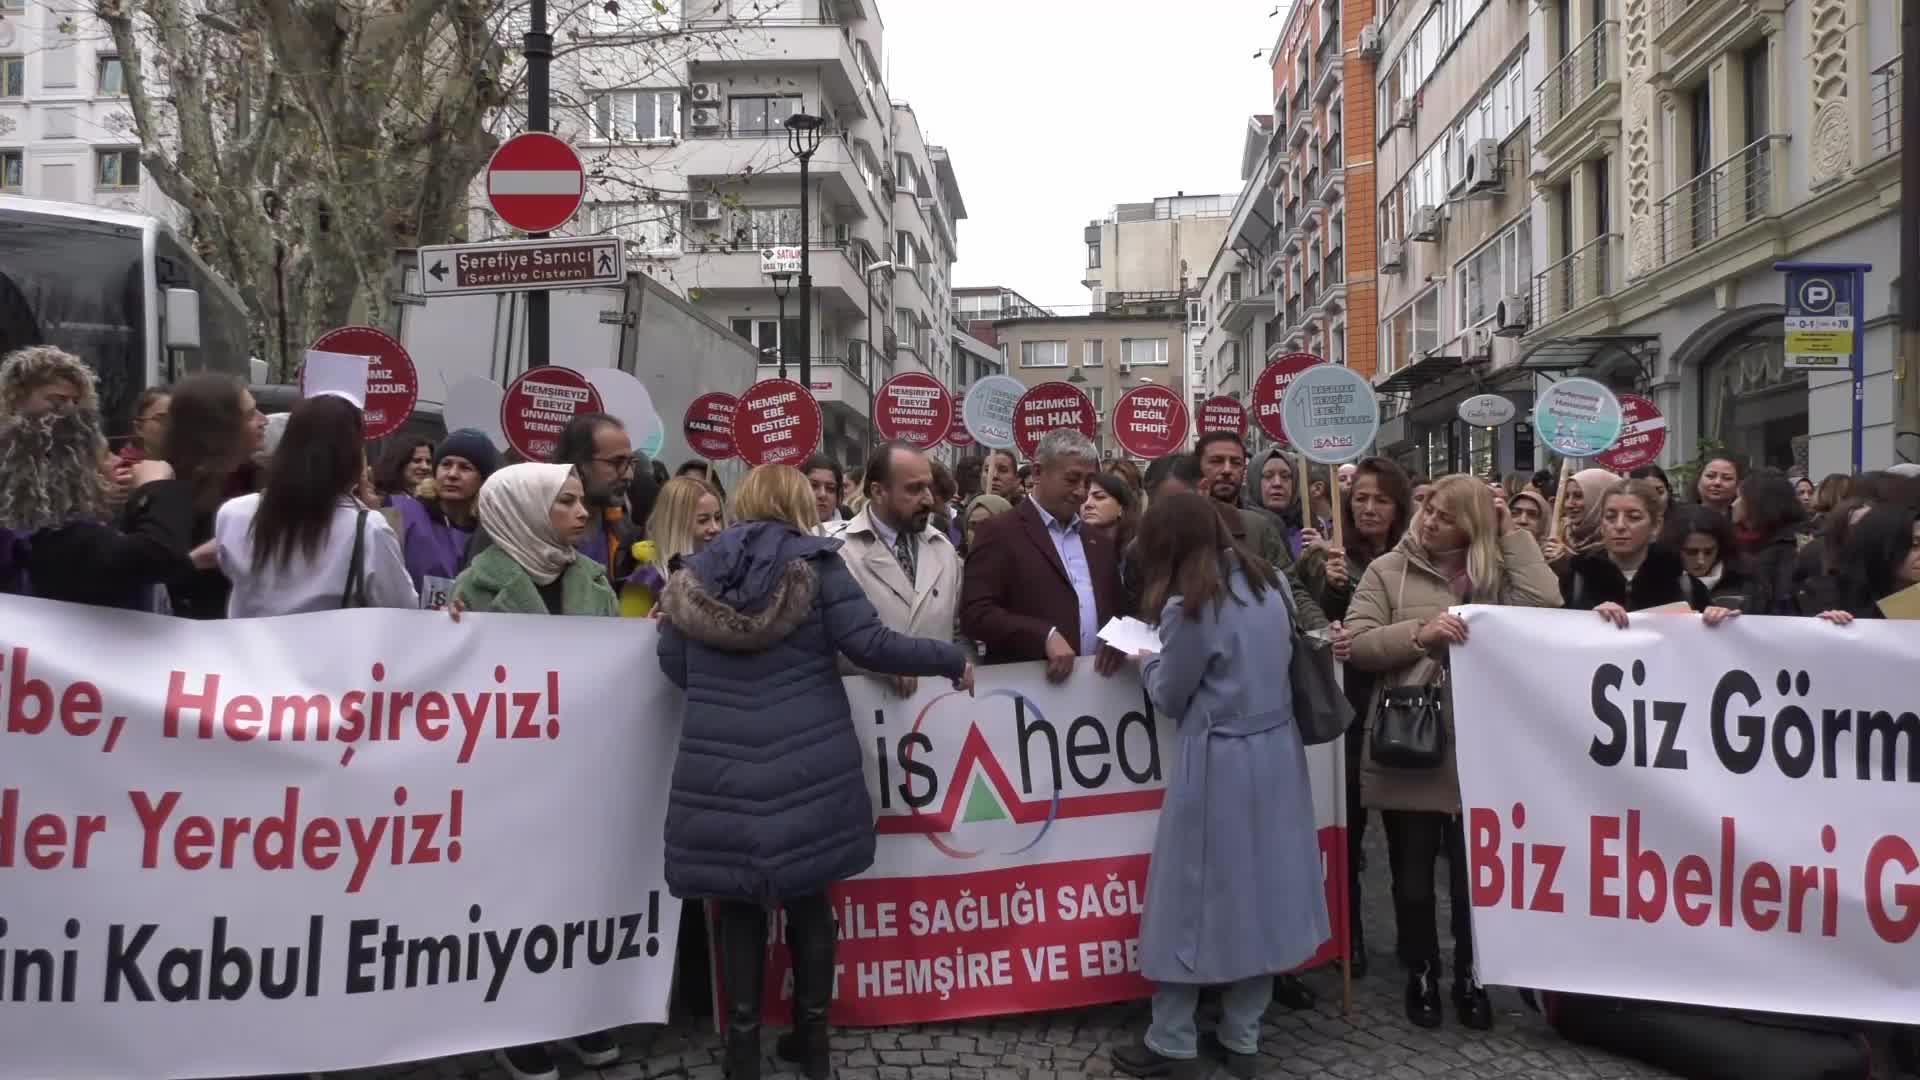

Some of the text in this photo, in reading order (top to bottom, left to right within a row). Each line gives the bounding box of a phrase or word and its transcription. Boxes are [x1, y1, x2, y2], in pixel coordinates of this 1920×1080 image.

[459, 252, 528, 271] Şerefiye
[532, 267, 587, 280] Cistern)
[747, 391, 797, 410] HEMŞİRE
[763, 407, 785, 419] EBE
[1047, 410, 1083, 426] HAK
[1218, 415, 1240, 425] HAK
[689, 421, 711, 432] KARA
[751, 415, 800, 434] DESTEĞE
[763, 429, 792, 443] GEBE
[0, 648, 560, 766] be, Hemşireyiz!
[1589, 659, 1689, 770] Siz
[128, 785, 464, 893] Yerdeyiz!
[1470, 802, 1566, 913] Biz
[1590, 809, 1838, 937] Ebeleri
[909, 882, 1047, 937] SAĞLIĞI
[103, 914, 324, 1002] Kabul
[346, 890, 661, 1002] Etmiyoruz!
[857, 946, 1013, 1000] HEMŞİRE
[1021, 942, 1070, 984] VE
